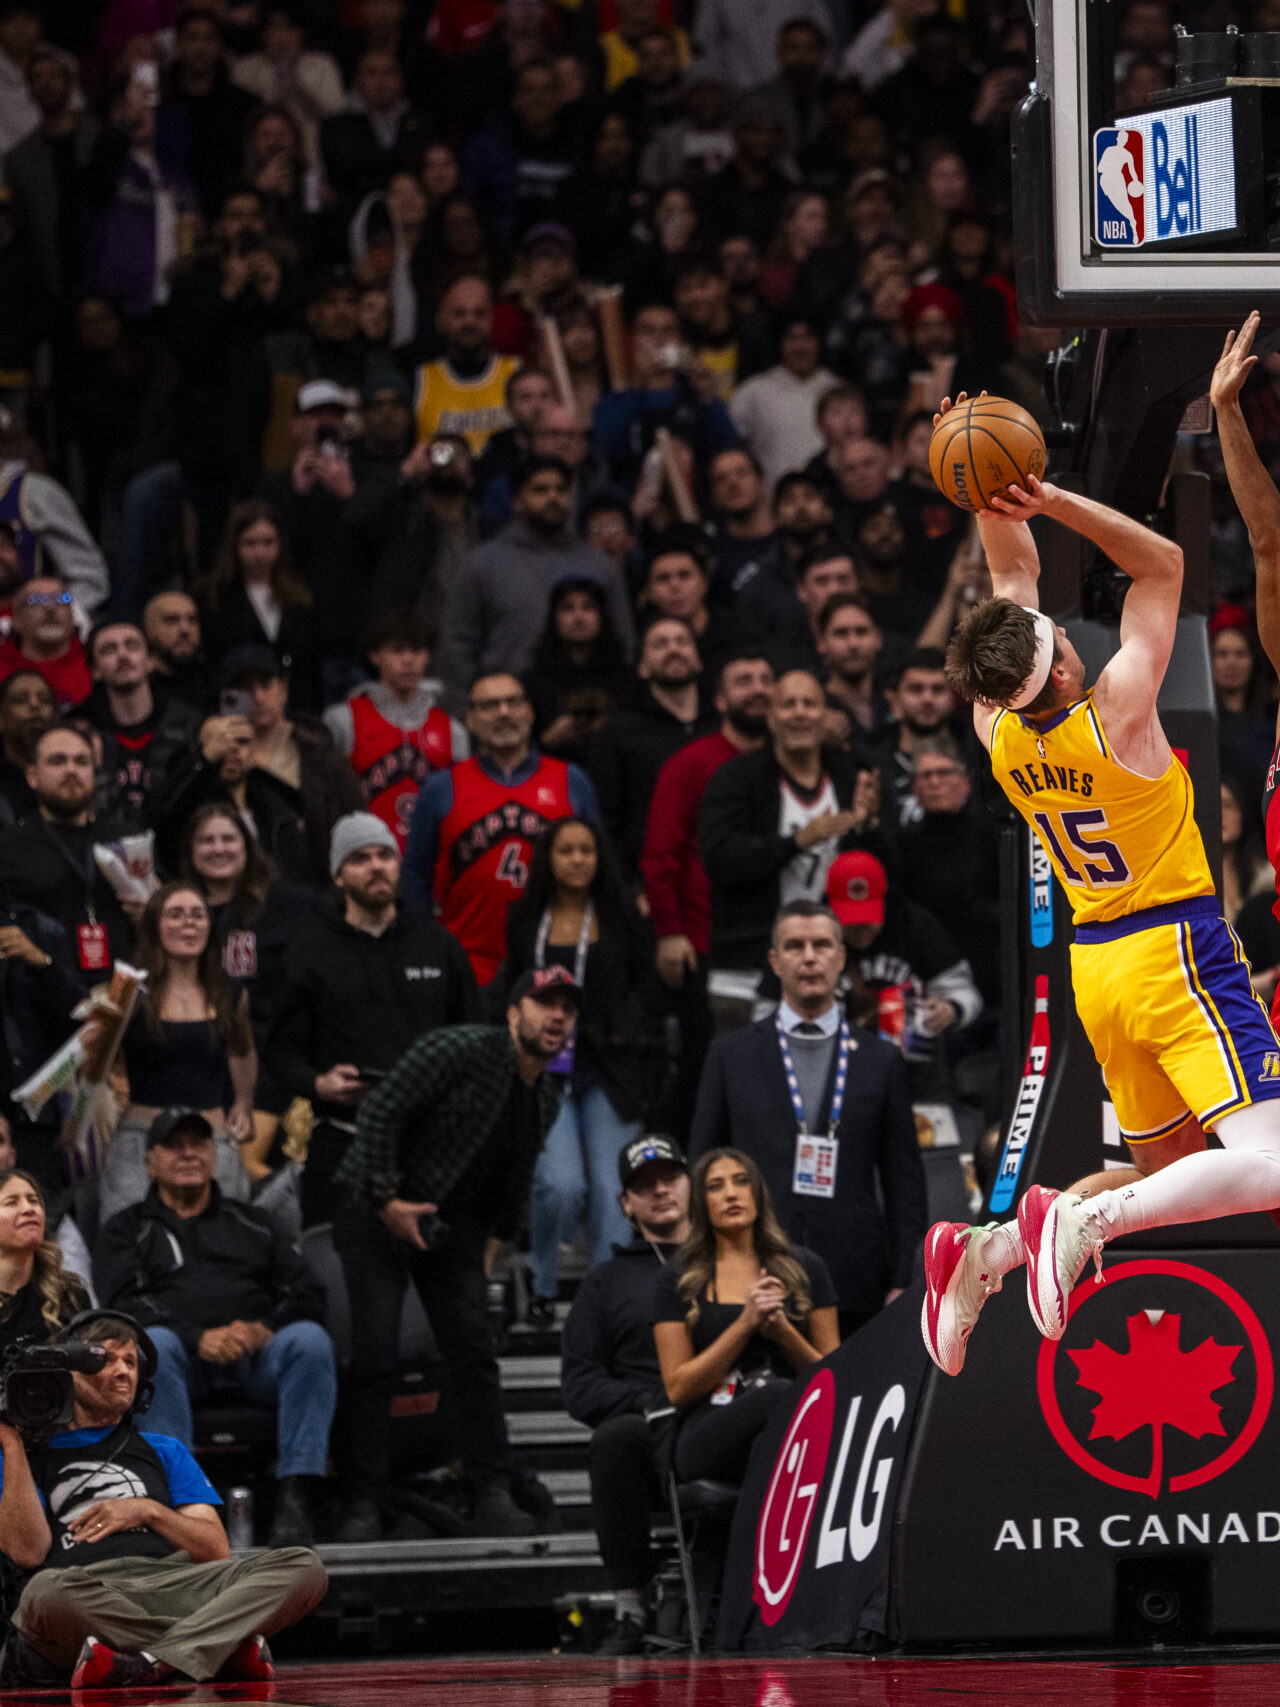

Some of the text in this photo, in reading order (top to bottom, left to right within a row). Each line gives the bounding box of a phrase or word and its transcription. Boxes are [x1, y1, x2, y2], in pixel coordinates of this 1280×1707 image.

[1151, 114, 1201, 237] Bell
[1102, 220, 1128, 240] NBA
[1009, 762, 1094, 797] REAVES
[495, 841, 528, 889] 4
[1032, 806, 1134, 890] 15
[1001, 1045, 1047, 1180] PRIME
[815, 1383, 906, 1570] LG
[993, 1517, 1085, 1551] AIR
